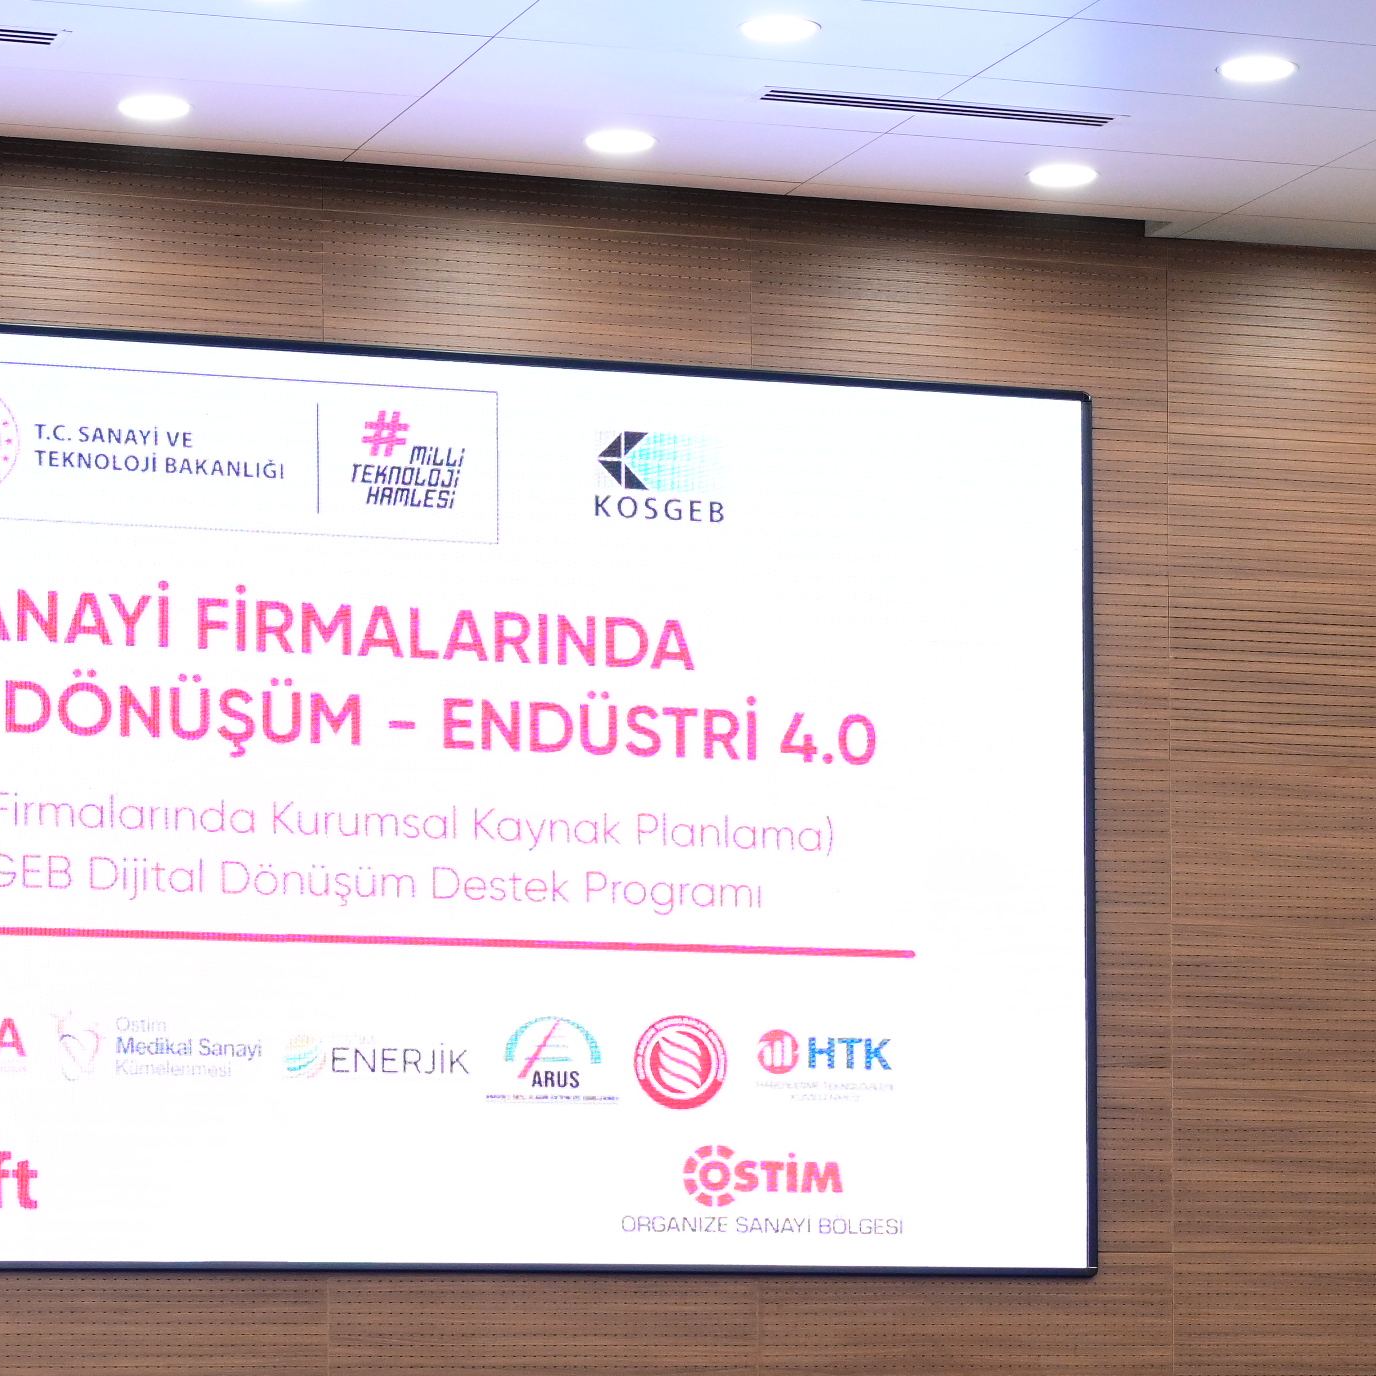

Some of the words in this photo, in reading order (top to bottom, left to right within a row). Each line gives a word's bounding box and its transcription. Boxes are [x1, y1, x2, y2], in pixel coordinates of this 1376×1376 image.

[34, 424, 71, 441] T.C.
[79, 426, 158, 446] SANAYİ
[167, 432, 192, 448] VE
[34, 450, 156, 472] TEKNOLOJİ
[166, 457, 284, 479] BAKANLIĞI
[595, 495, 724, 523] KOSGEB
[197, 584, 695, 671] FİRMALARINDA
[5, 668, 361, 758] DÖNÜŞÜM
[443, 690, 757, 760] ENDÜSTRİ
[780, 712, 877, 765] 4.0
[273, 801, 457, 840] Kurumsal
[474, 808, 621, 851] Kaynak
[637, 812, 834, 856] Planlama)
[89, 856, 204, 900] Dijital
[221, 860, 416, 907] Dönüşüm
[433, 866, 569, 902] Destek
[586, 871, 762, 916] Programı
[198, 1037, 264, 1060] Sanayi
[332, 1043, 468, 1074] ENERJİK
[808, 1037, 891, 1070] HTK
[532, 1071, 579, 1088] ARUS
[622, 1215, 728, 1232] ORGANİZE
[736, 1216, 810, 1233] SANAYİ
[819, 1218, 903, 1234] BÖLGESİ
